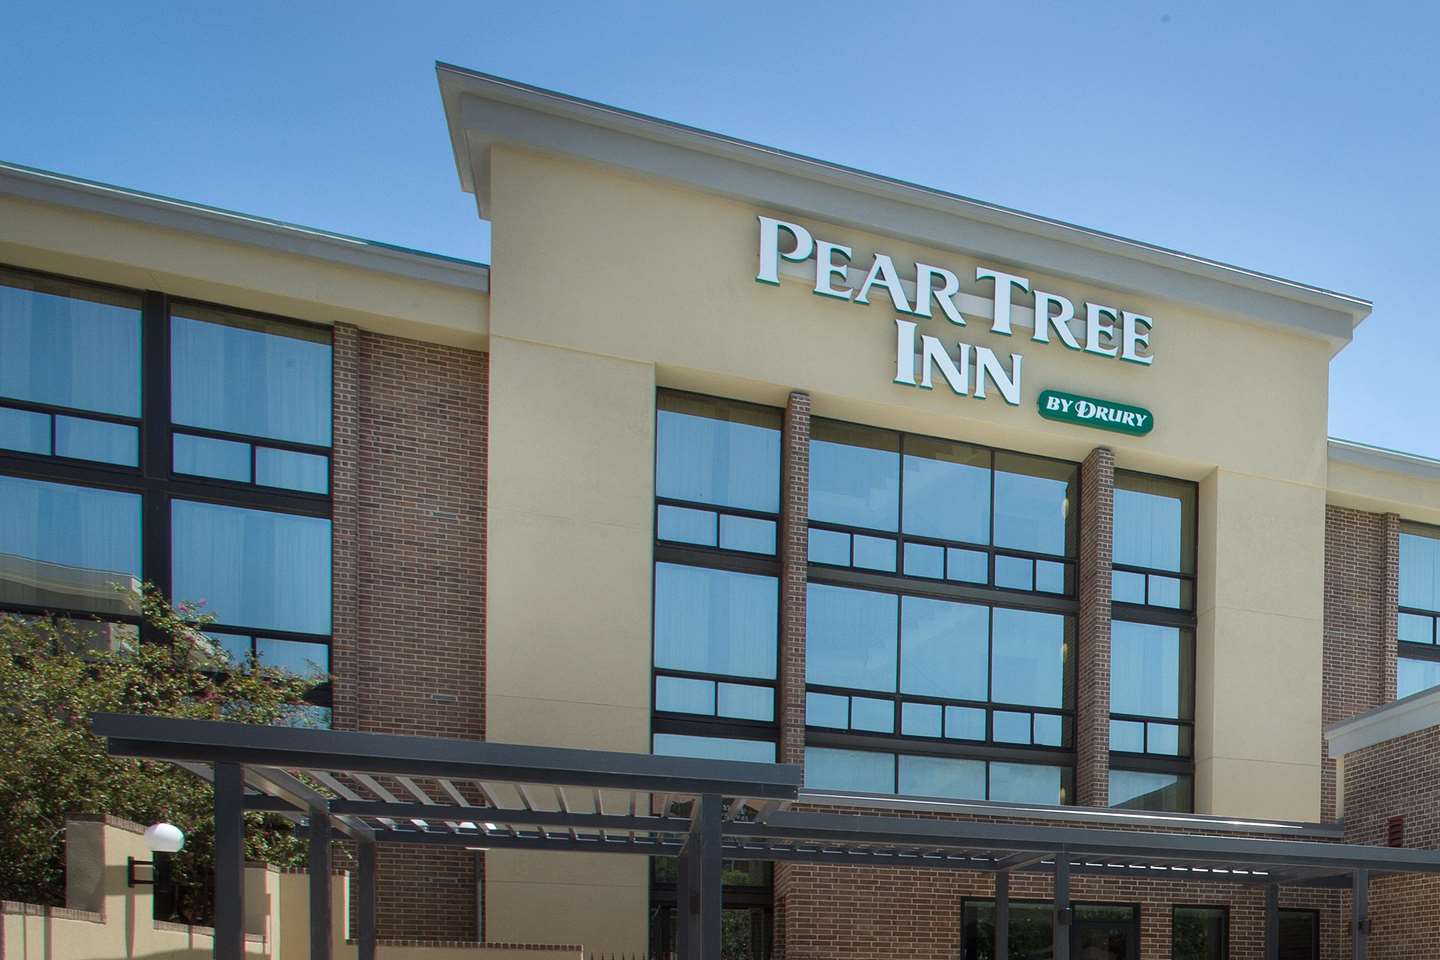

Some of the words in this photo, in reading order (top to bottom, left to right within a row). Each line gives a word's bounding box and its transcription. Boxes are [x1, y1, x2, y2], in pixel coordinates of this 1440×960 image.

[755, 215, 968, 327] PEAR
[975, 266, 1155, 366] TREE
[893, 319, 1025, 406] INN
[1046, 396, 1074, 414] BY
[1074, 400, 1149, 428] DRURY
